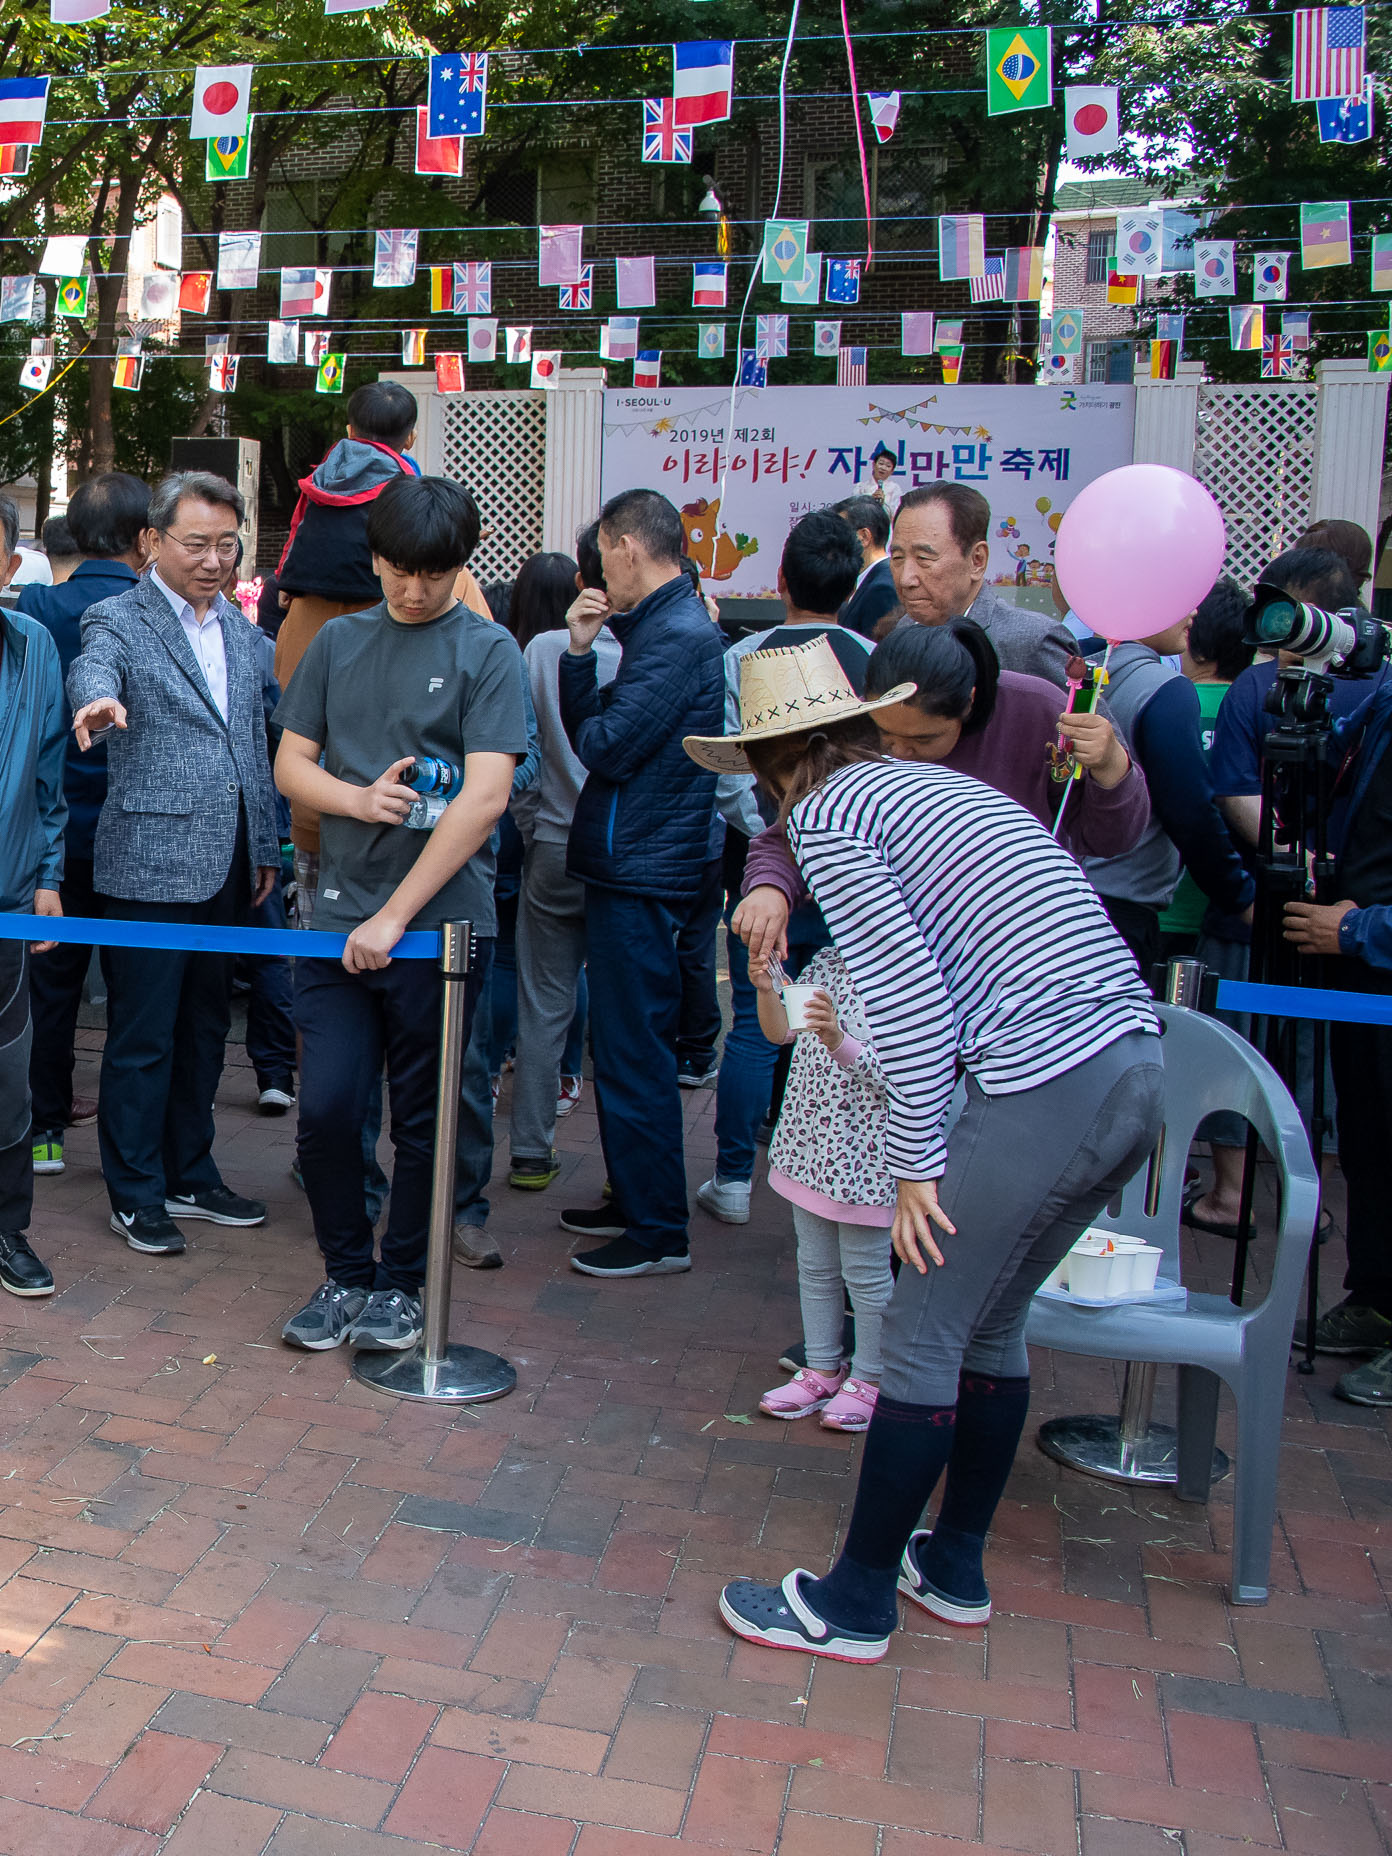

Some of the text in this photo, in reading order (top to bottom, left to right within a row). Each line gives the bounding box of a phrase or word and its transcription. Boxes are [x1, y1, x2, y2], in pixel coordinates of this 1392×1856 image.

[669, 427, 775, 443] 2019년 제2회
[999, 447, 1071, 481] 축제
